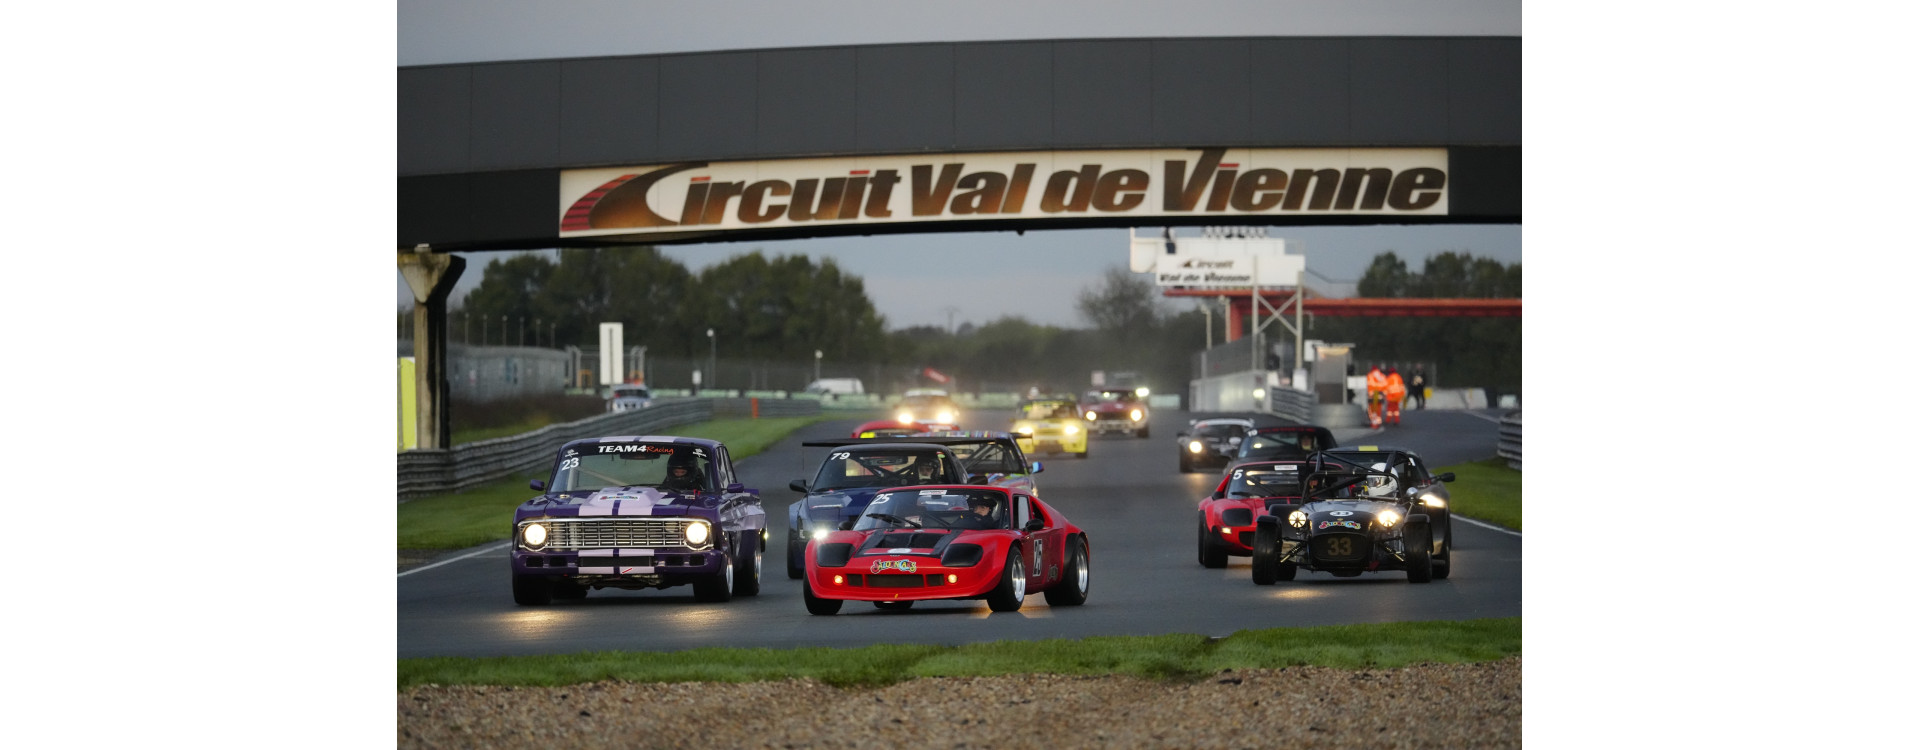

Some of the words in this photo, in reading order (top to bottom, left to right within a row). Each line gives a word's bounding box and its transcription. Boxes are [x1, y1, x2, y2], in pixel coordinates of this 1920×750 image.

[562, 162, 902, 231] Circuit
[911, 163, 1037, 215] Val
[1039, 164, 1150, 214] de
[1164, 149, 1447, 212] Vienne
[598, 445, 646, 453] TEAM4
[646, 446, 674, 455] Racing
[830, 452, 851, 460] 79
[561, 457, 580, 471] 23
[1233, 469, 1243, 480] 5
[870, 493, 893, 505] 25
[1328, 538, 1351, 556] 33
